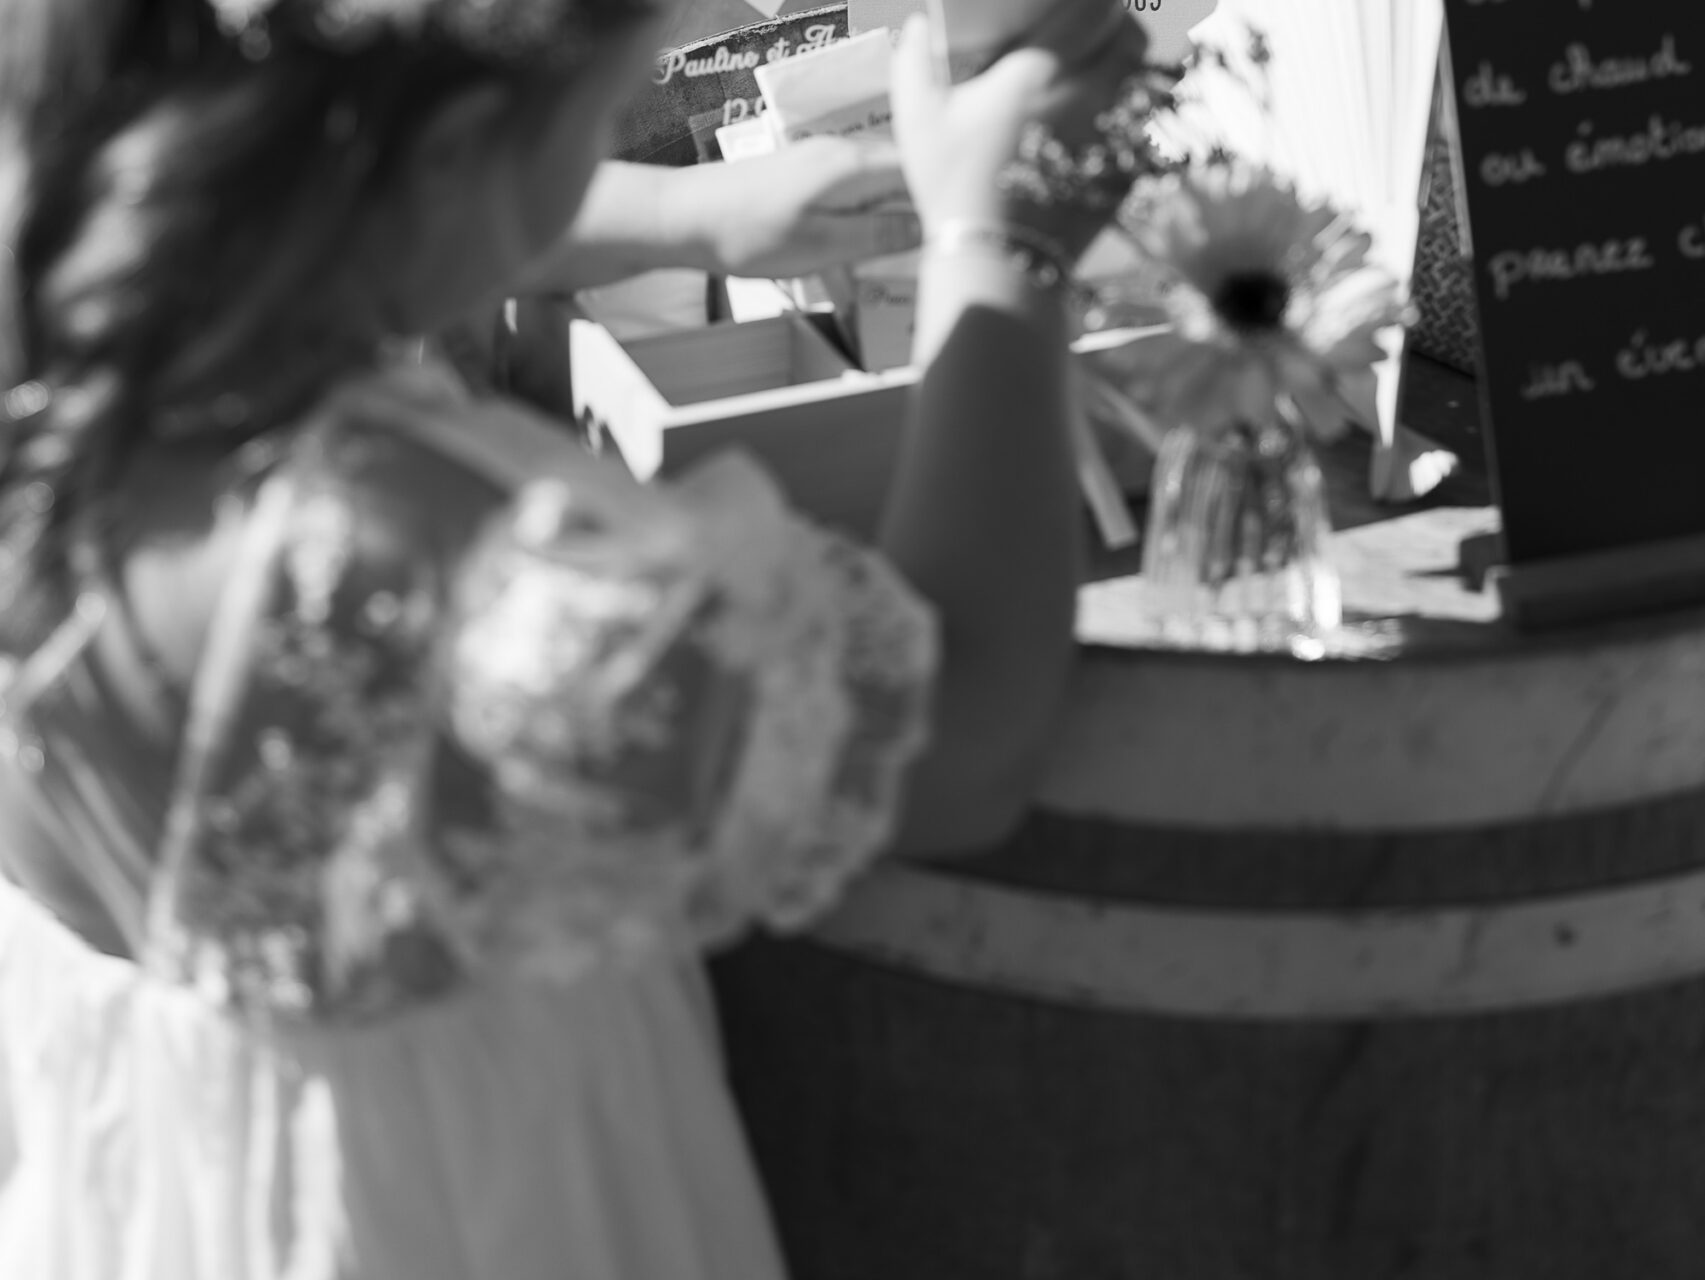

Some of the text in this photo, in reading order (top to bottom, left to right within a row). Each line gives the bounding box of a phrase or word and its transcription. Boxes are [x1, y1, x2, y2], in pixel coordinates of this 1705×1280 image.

[653, 46, 760, 84] Pauline
[1462, 32, 1692, 109] de chaud
[1564, 112, 1705, 175] émotio
